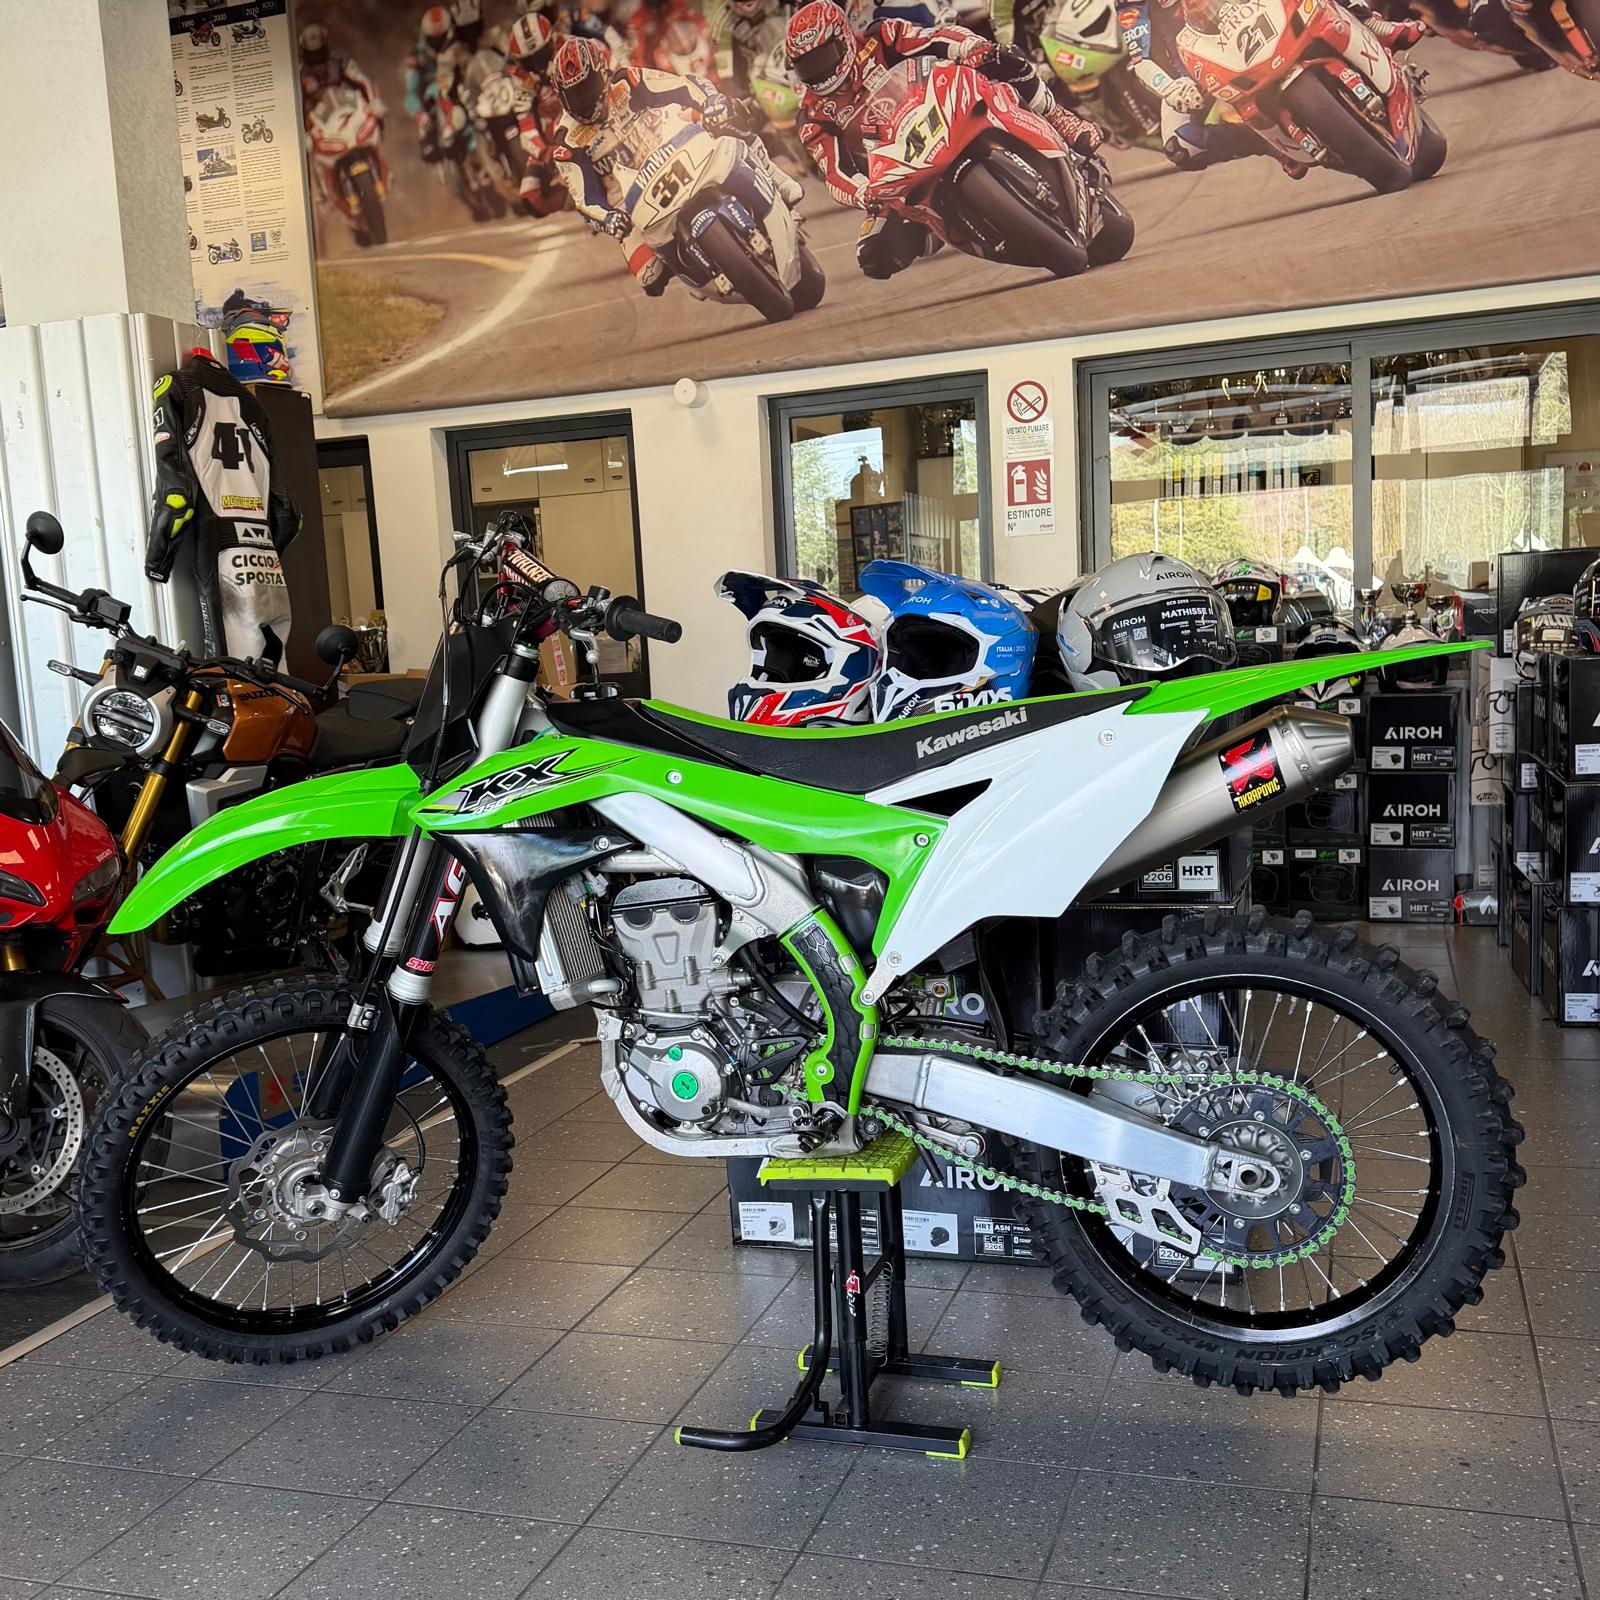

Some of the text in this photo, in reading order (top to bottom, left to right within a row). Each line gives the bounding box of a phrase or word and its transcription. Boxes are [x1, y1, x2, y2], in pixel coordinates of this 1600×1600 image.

[1236, 11, 1279, 66] 21
[904, 104, 944, 163] 41
[1006, 424, 1050, 435] VIETATO FUMARE
[1007, 507, 1052, 520] ESTINTORE
[232, 554, 274, 568] CICCIO
[1155, 570, 1193, 581] AIROH
[1112, 615, 1146, 630] AIROH
[915, 705, 1030, 760] Kawasaki
[1384, 726, 1443, 740] AIROH
[1412, 753, 1432, 761] HRT
[458, 748, 573, 813] KX
[1237, 778, 1281, 810] AKRAPOVIC
[1382, 803, 1441, 817] AIROH
[1411, 830, 1431, 838] HRT
[1182, 865, 1214, 876] HRT
[1144, 873, 1172, 882] 2206
[1381, 879, 1440, 892] AIROH
[1409, 904, 1429, 912] HRT
[128, 1084, 170, 1138] MAXXIS
[994, 1224, 1011, 1232] ASN
[984, 1235, 1004, 1243] ECE
